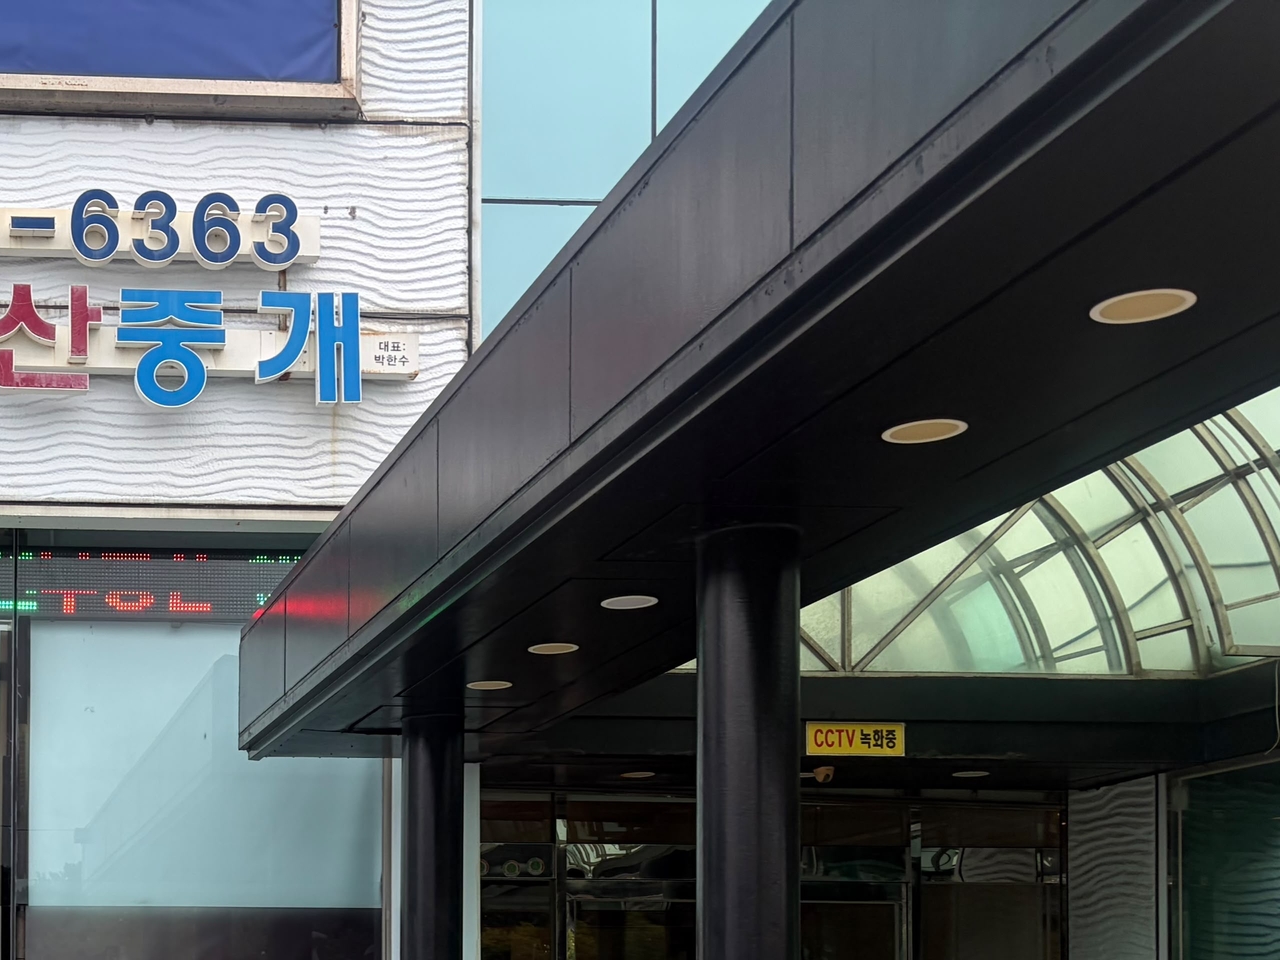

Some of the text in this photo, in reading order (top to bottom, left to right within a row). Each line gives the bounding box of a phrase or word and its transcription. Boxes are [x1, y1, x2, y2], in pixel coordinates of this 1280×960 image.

[379, 341, 406, 352] 대표:
[374, 354, 410, 367] 박한수
[813, 728, 897, 749] CCTV 녹화중
